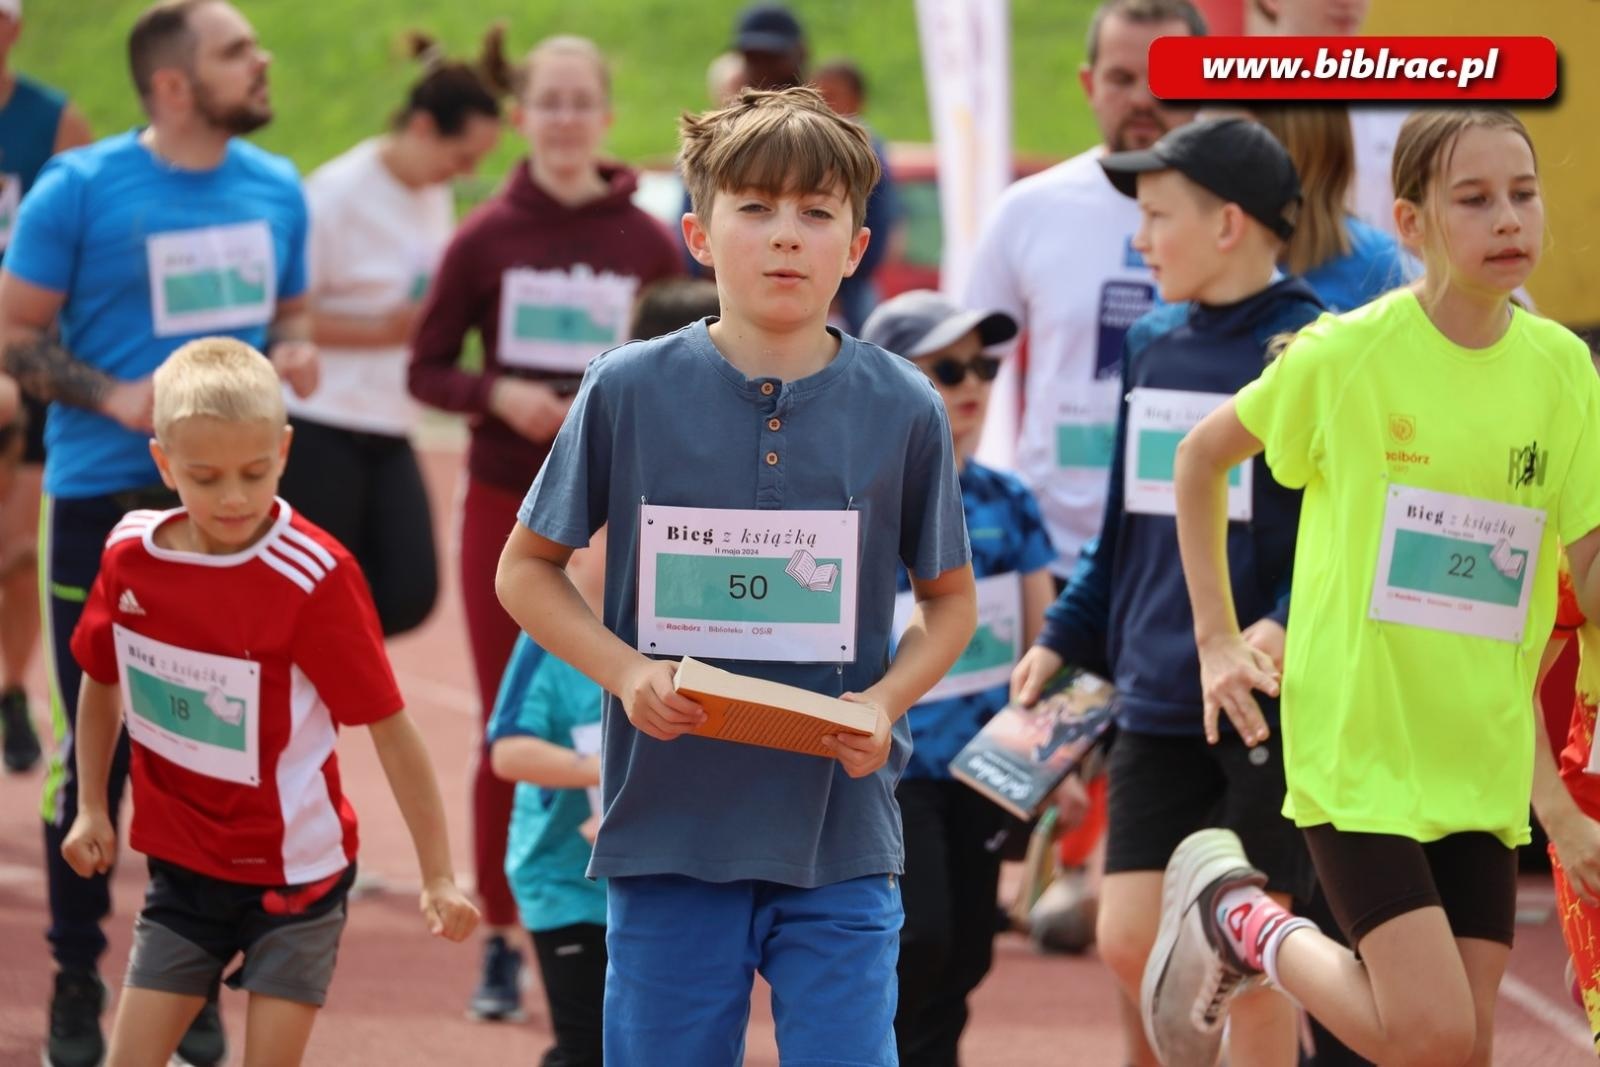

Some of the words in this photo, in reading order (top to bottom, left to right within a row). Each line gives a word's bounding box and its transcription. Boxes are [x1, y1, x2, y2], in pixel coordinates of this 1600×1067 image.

[1385, 450, 1430, 465] acibórz
[1407, 505, 1444, 525] Bieg
[1463, 514, 1516, 537] książką
[667, 525, 714, 545] Bieg
[722, 531, 732, 543] z
[741, 528, 817, 548] książką
[721, 548, 740, 556] maja
[741, 548, 759, 556] 2024
[1448, 553, 1476, 579] 22
[729, 574, 768, 600] 50
[666, 622, 702, 633] Racibórz
[708, 625, 744, 634] Biblioteka
[751, 627, 773, 635] OSiR
[170, 693, 190, 721] 18
